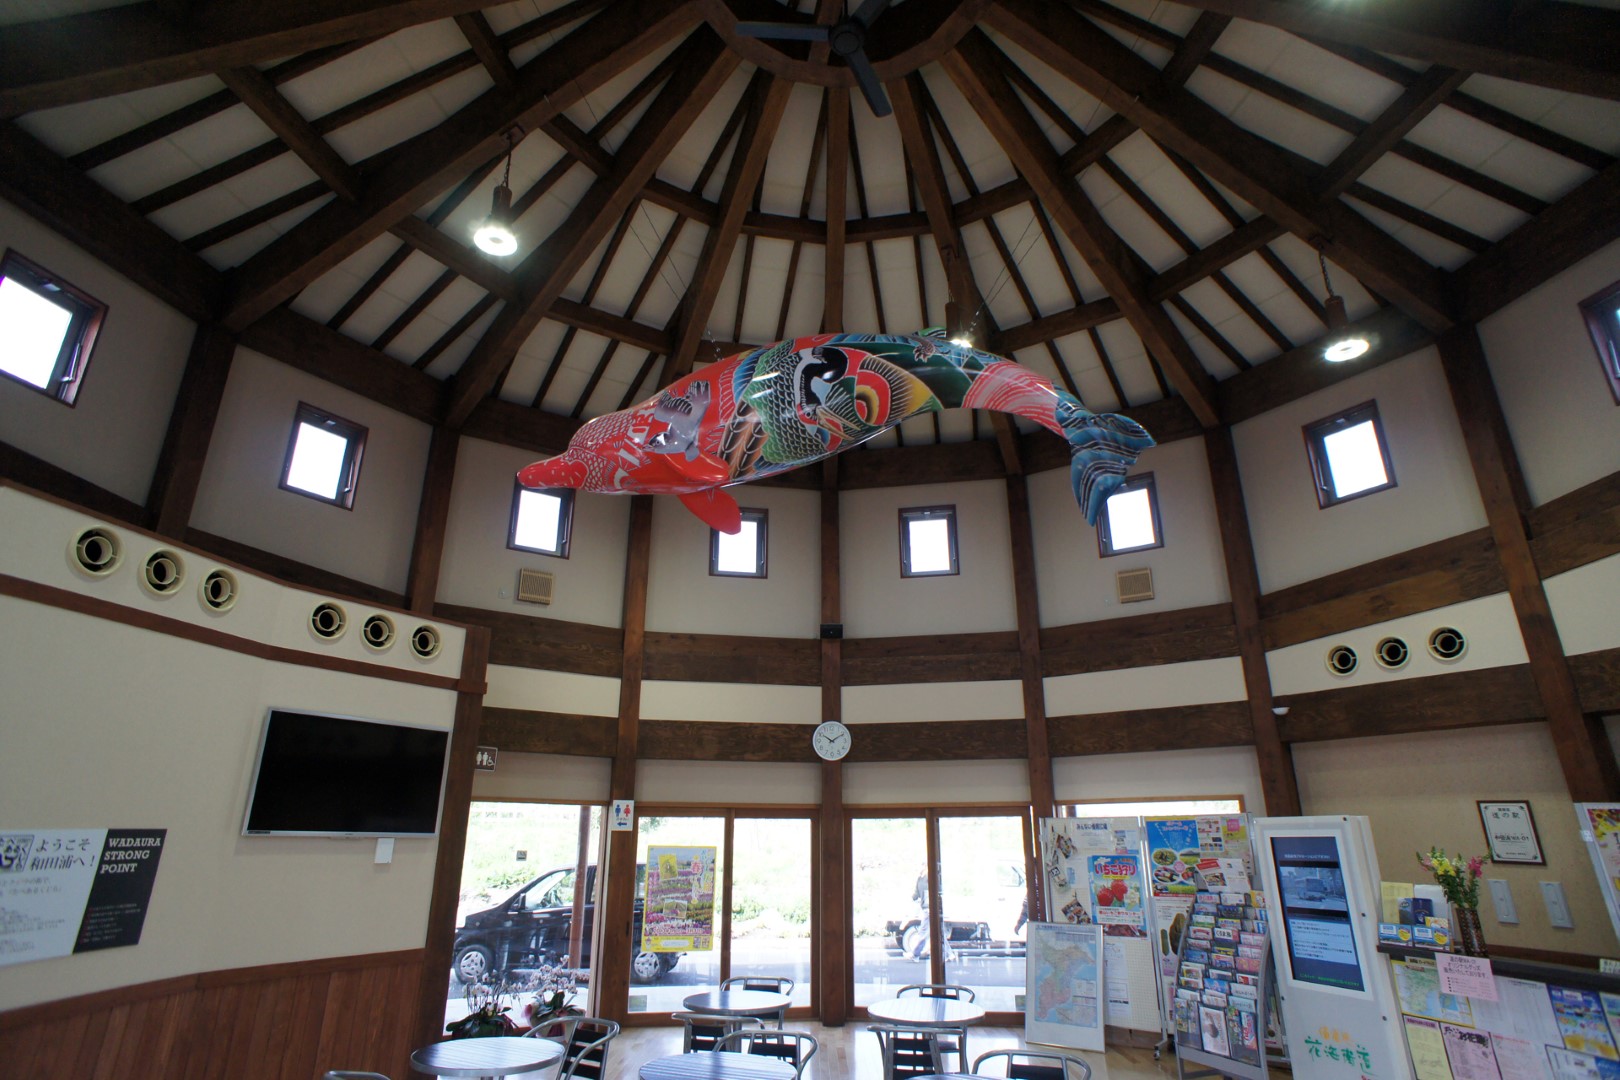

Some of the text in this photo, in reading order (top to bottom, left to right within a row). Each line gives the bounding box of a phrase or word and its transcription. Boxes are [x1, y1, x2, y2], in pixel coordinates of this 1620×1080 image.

[36, 838, 91, 852] ようこそ
[109, 837, 161, 848] WADAURA
[104, 850, 150, 861] STRONG
[100, 863, 138, 874] POINT
[1095, 863, 1136, 876] いちご狩り
